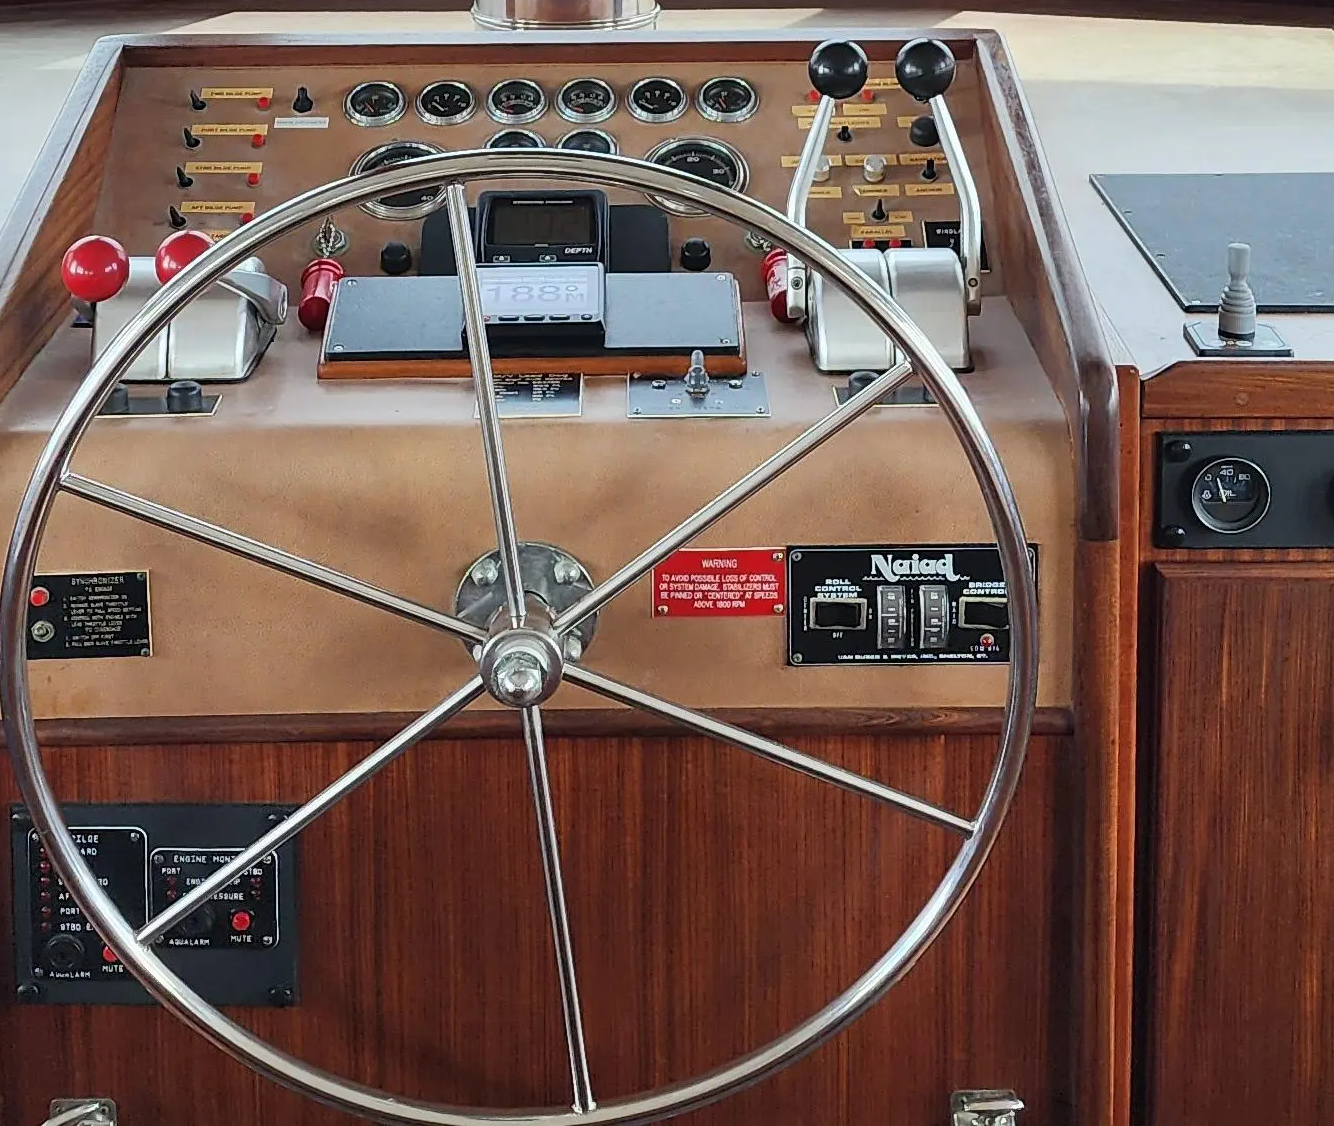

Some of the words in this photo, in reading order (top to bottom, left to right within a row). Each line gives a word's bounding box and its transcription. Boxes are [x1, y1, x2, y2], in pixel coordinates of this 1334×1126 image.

[564, 246, 593, 254] DEPTH
[1219, 468, 1234, 476] 40
[701, 558, 738, 568] WARNING
[870, 554, 961, 582] Naiad
[662, 574, 669, 582] TO
[671, 574, 689, 582] AVOID
[690, 574, 720, 582] POSSIBLE
[721, 574, 739, 582] LOSS
[739, 574, 747, 582] OF
[749, 574, 777, 582] CONTROL
[659, 583, 668, 591] OR
[669, 583, 694, 591] SYSTEM
[723, 583, 762, 591] STABILIZERS
[763, 583, 779, 591] MUST
[661, 592, 669, 600] BE
[670, 592, 693, 600] PINNED
[693, 592, 703, 600] OR
[745, 592, 752, 600] AT
[753, 592, 779, 600] SPEEDS
[693, 600, 713, 609] ABOVE
[732, 600, 745, 609] RPM
[73, 834, 99, 844] ILGE
[173, 855, 207, 864] ENGINE
[231, 935, 253, 943] MUTE
[101, 964, 124, 973] MUTE
